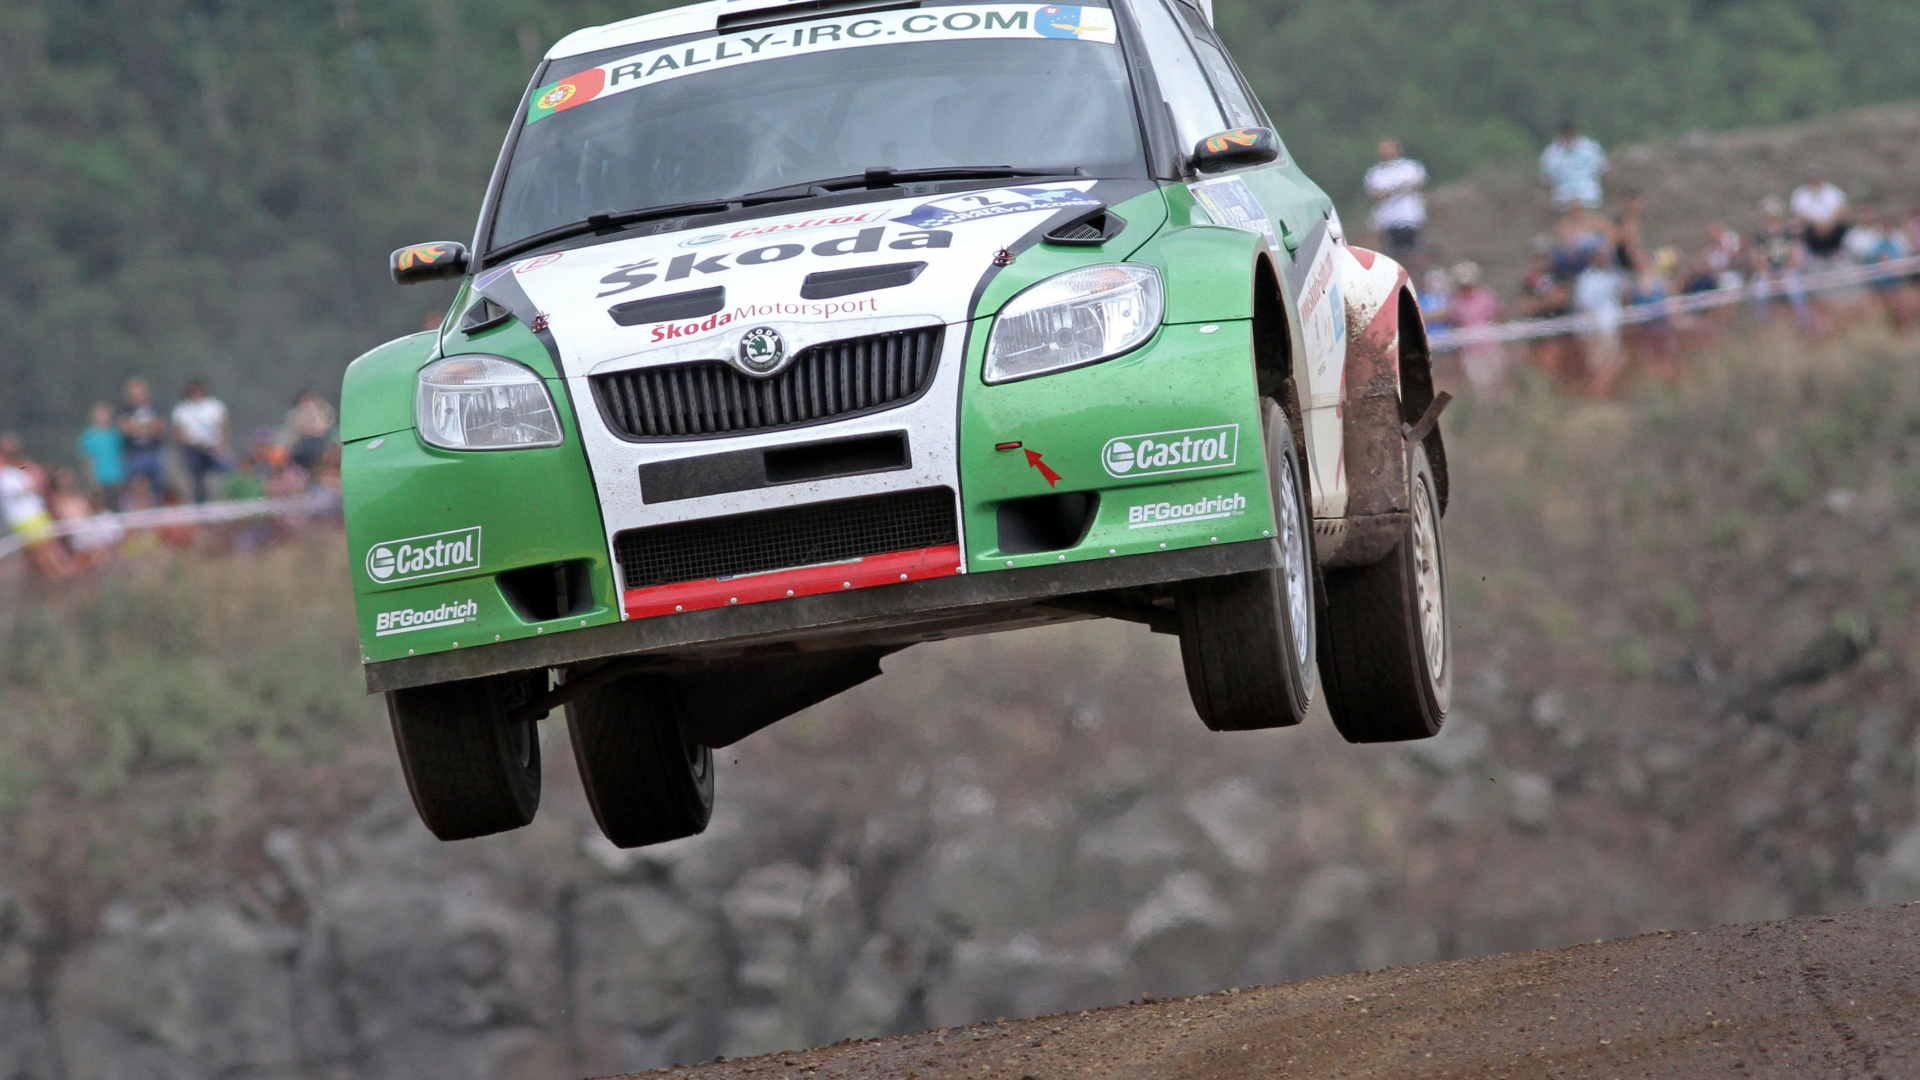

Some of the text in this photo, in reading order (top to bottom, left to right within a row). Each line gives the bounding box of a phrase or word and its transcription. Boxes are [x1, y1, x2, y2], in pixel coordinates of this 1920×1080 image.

[611, 11, 1028, 87] RALLY-IRC.COM
[962, 196, 1003, 206] 2
[729, 213, 871, 239] Castrol
[595, 226, 953, 298] Škoda
[1136, 431, 1229, 469] Castrol
[1128, 492, 1246, 524] BFGoodrich
[396, 534, 474, 574] Castrol
[376, 598, 478, 631] BFGoodrich
